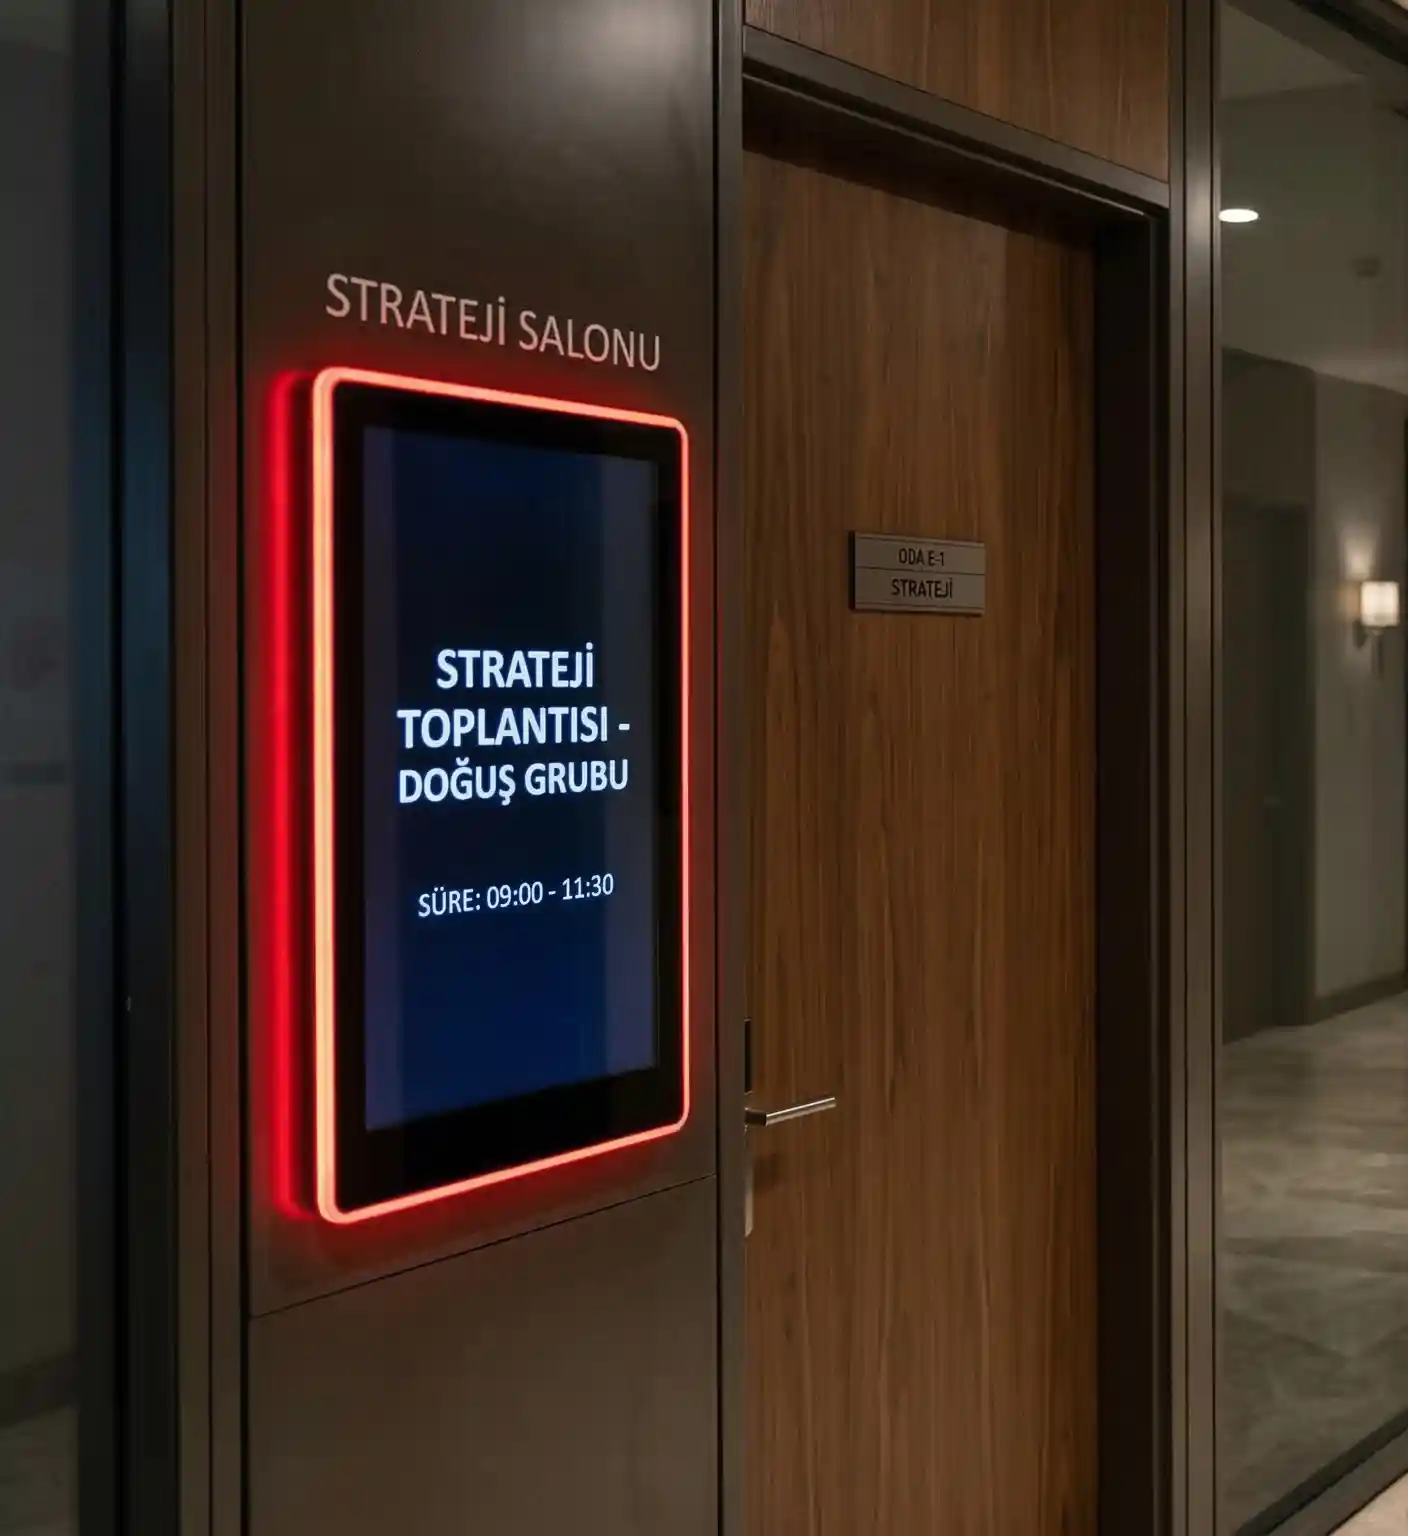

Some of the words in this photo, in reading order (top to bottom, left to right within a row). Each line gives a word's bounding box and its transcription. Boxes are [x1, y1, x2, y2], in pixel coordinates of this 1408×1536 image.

[325, 273, 506, 346] STRATEJİ
[518, 310, 662, 372] SALONU
[899, 548, 924, 566] ODA
[928, 550, 944, 567] E-1
[891, 577, 953, 599] STRATEJİ
[436, 642, 594, 689] STRATEJİ
[396, 705, 608, 749] TOPLANTISI
[618, 722, 630, 731] -
[399, 756, 516, 806] DOĞUŞ
[524, 758, 629, 796] GRUBU
[418, 887, 481, 918] SÜRE:
[486, 881, 543, 909] 09:00
[562, 873, 614, 901] 11:30
